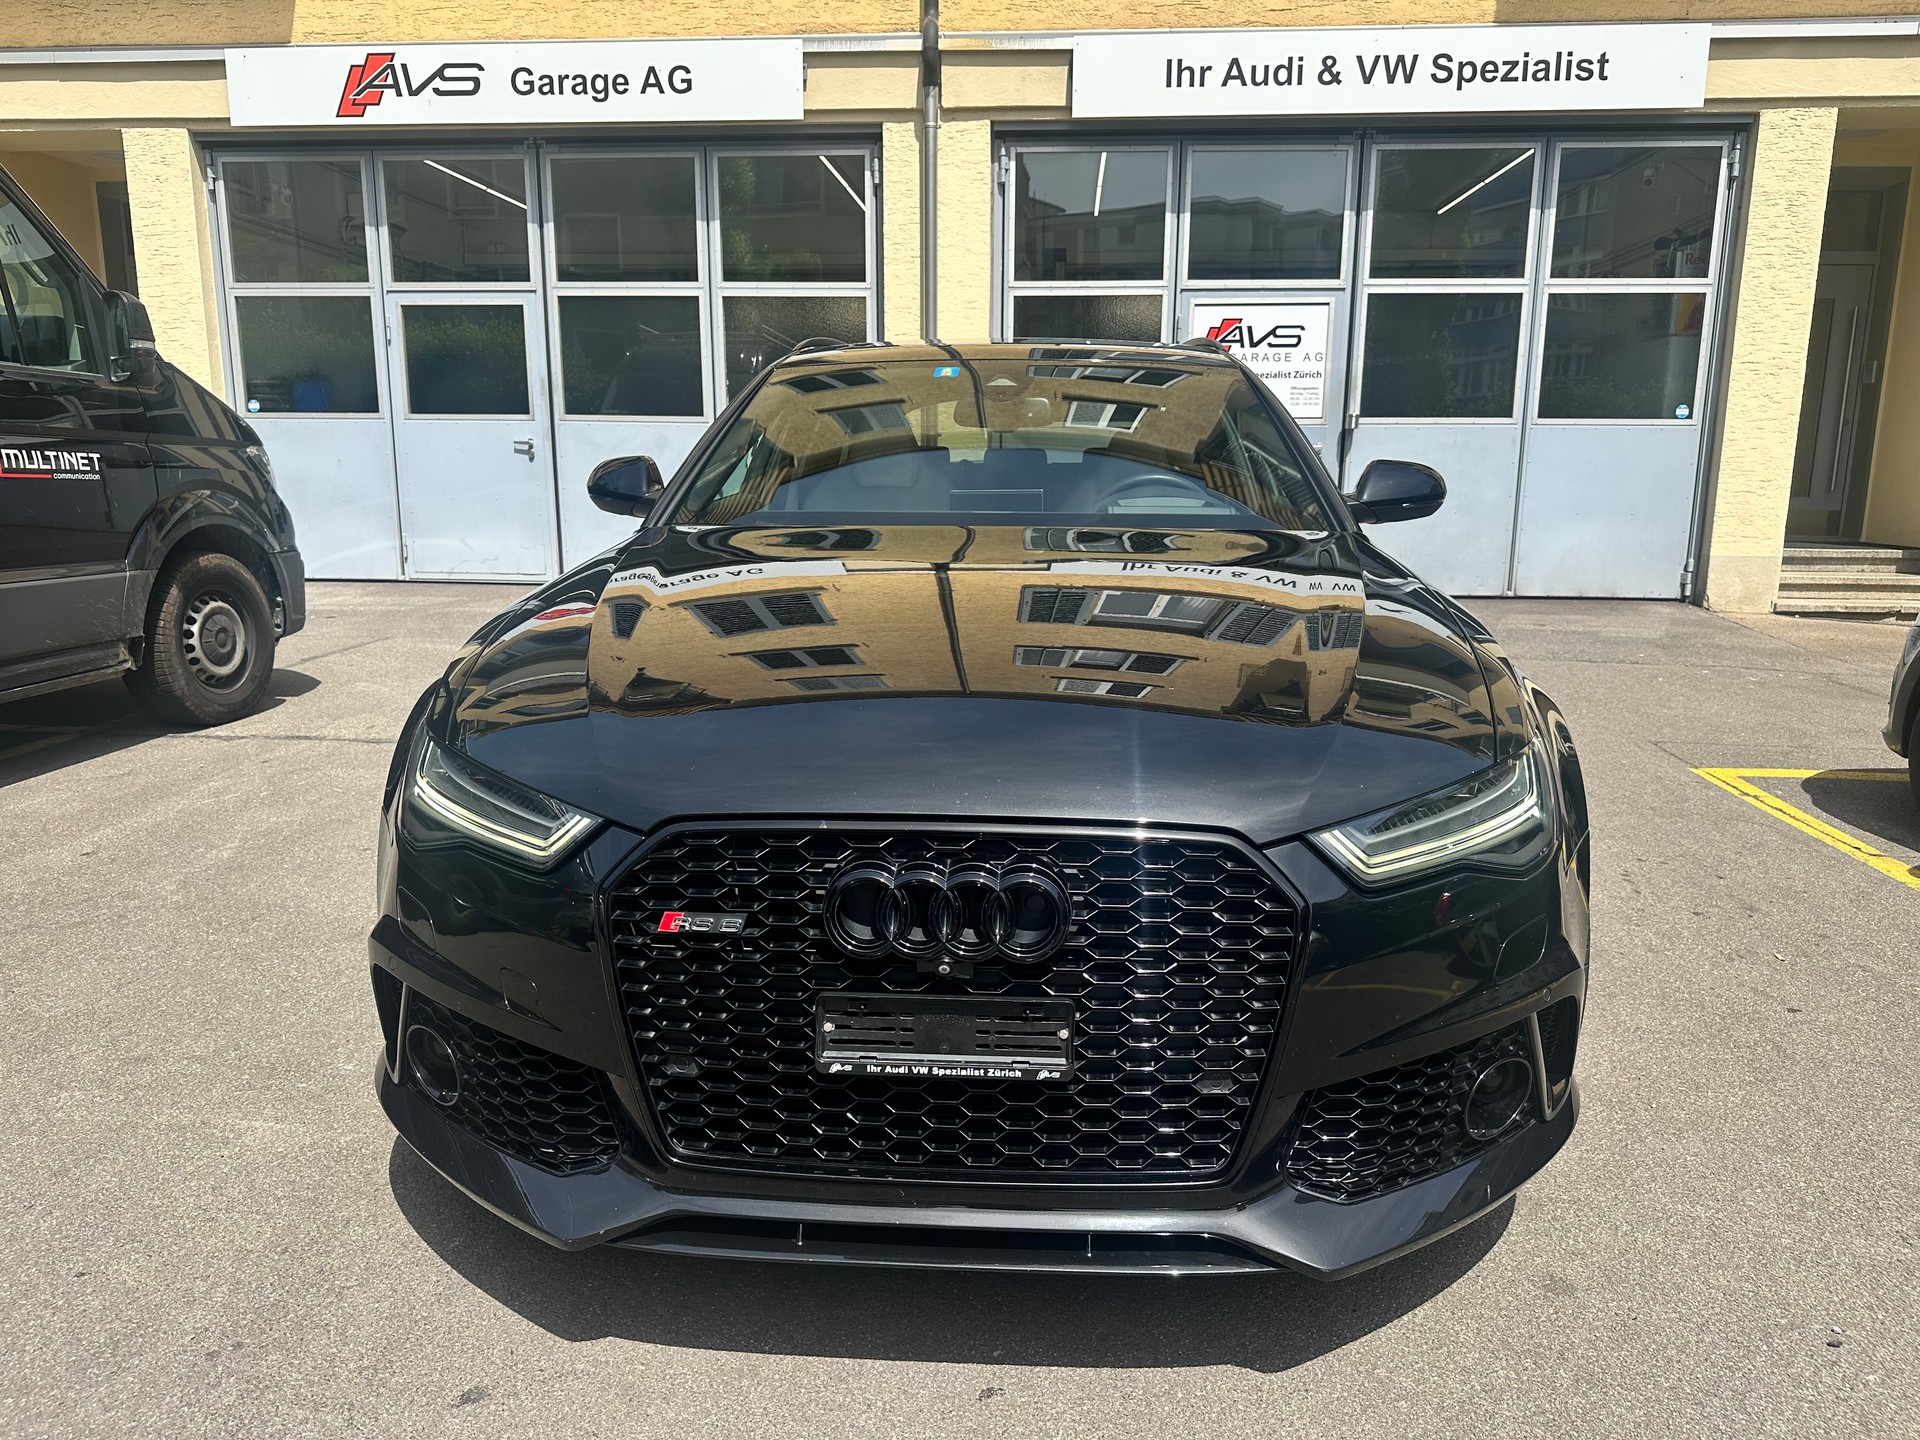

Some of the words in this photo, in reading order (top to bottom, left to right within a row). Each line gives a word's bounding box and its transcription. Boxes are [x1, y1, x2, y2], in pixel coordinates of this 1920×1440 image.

[1165, 58, 1213, 88] Ihr
[1221, 56, 1304, 87] Audi
[1317, 55, 1343, 86] &
[1356, 54, 1419, 85] VW
[1430, 51, 1610, 91] Spezialist
[352, 62, 485, 97] AVS
[510, 66, 630, 102] Garage
[640, 65, 693, 95] AG
[1219, 325, 1306, 348] AVS
[1231, 352, 1292, 363] ARAGE
[1303, 352, 1324, 363] AG
[1293, 370, 1323, 379] Zürich
[0, 448, 101, 471] MULTINET
[670, 916, 714, 932] RS
[866, 1064, 882, 1073] Ihr
[885, 1065, 909, 1074] Audi
[911, 1066, 929, 1075] VW
[931, 1066, 985, 1077] Spezialist
[987, 1068, 1022, 1078] Zürich
